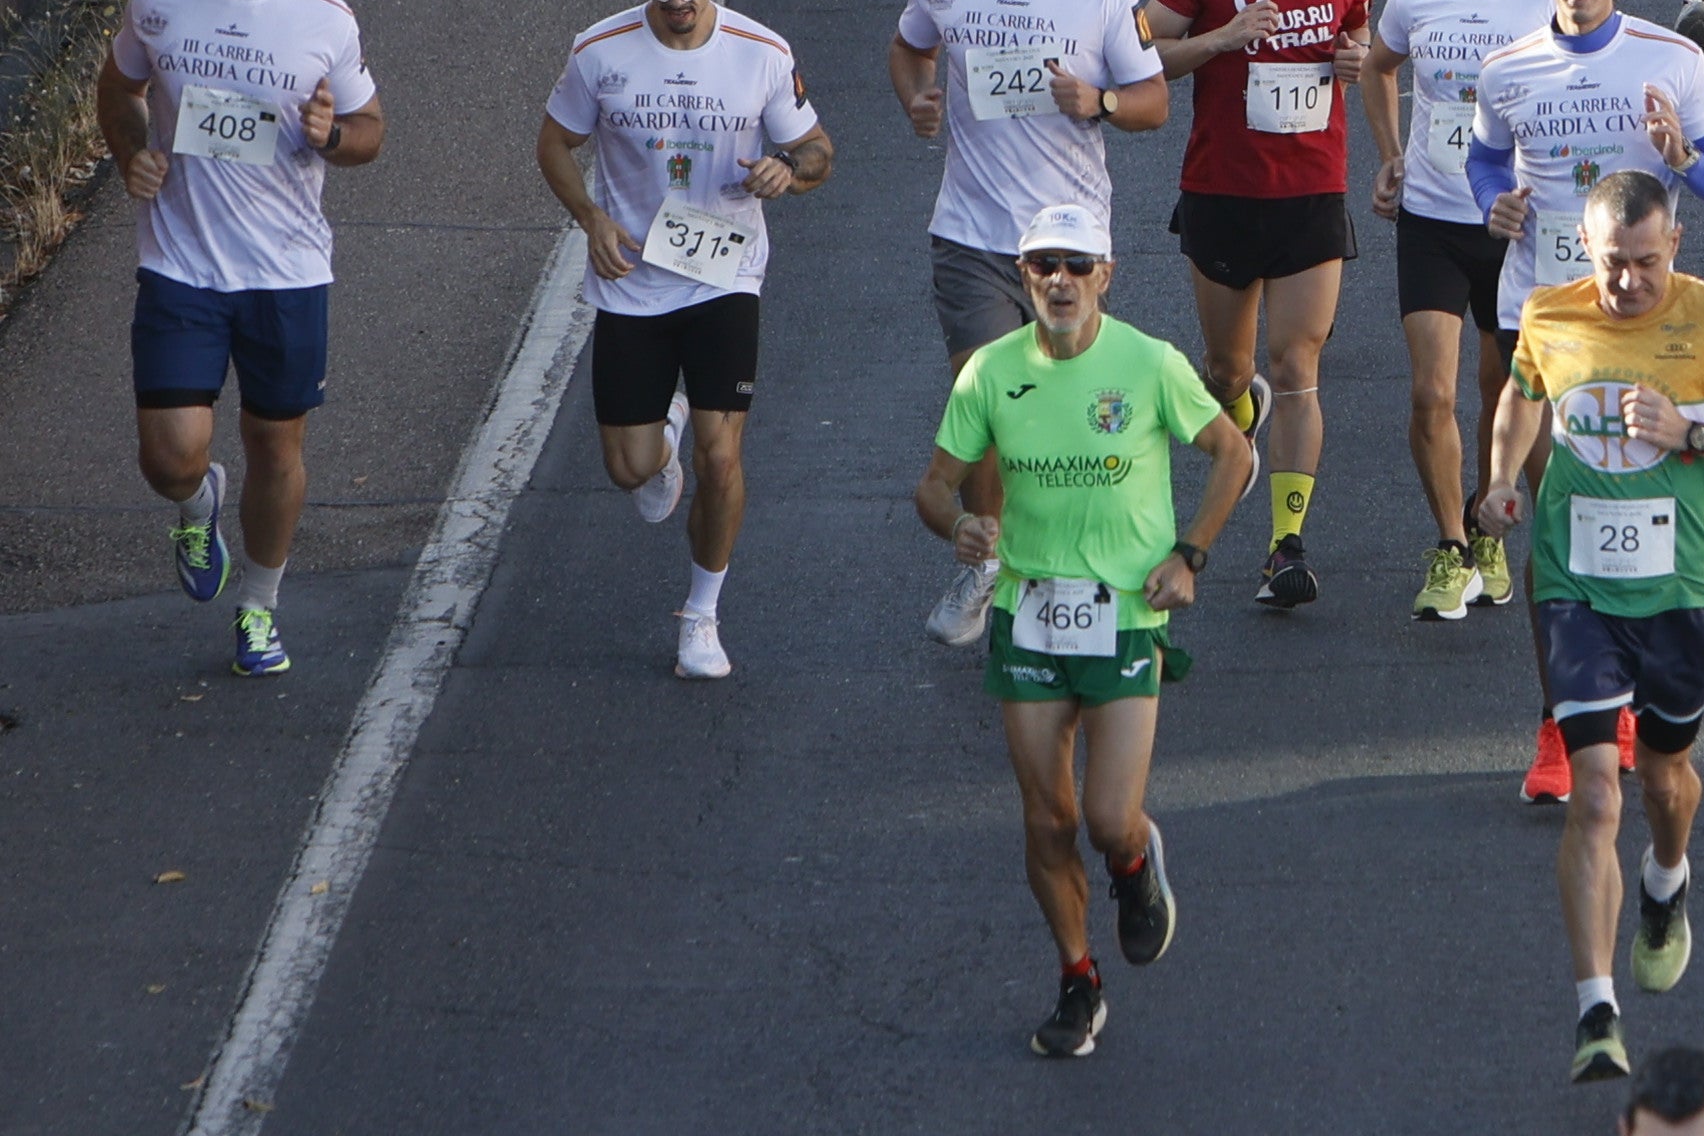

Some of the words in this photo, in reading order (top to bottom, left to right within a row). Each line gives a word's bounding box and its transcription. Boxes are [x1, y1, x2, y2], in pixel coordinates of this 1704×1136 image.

[965, 10, 982, 25] III
[987, 12, 1056, 33] CARRERA
[183, 38, 200, 53] III
[204, 41, 275, 66] CARRERA
[1266, 25, 1335, 52] TRAIL
[1428, 31, 1444, 44] III
[1448, 31, 1516, 46] CARRERA
[157, 53, 239, 82] GVARDIA
[246, 67, 299, 92] CIVIL
[988, 67, 1046, 97] 242
[634, 93, 651, 108] III
[656, 93, 726, 112] CARRERA
[1269, 85, 1319, 112] 110
[1536, 100, 1552, 116] III
[1558, 96, 1633, 115] CARRERA
[197, 111, 258, 143] 408
[609, 111, 692, 131] GVARDIA
[1514, 115, 1598, 140] GVARDIA
[665, 138, 716, 153] Iberdrola
[1570, 143, 1625, 157] Iberdrola
[667, 221, 724, 260] 311
[1554, 235, 1592, 263] 52
[1035, 471, 1113, 489] TELECOM
[1599, 524, 1641, 554] 28
[1036, 602, 1093, 631] 466
